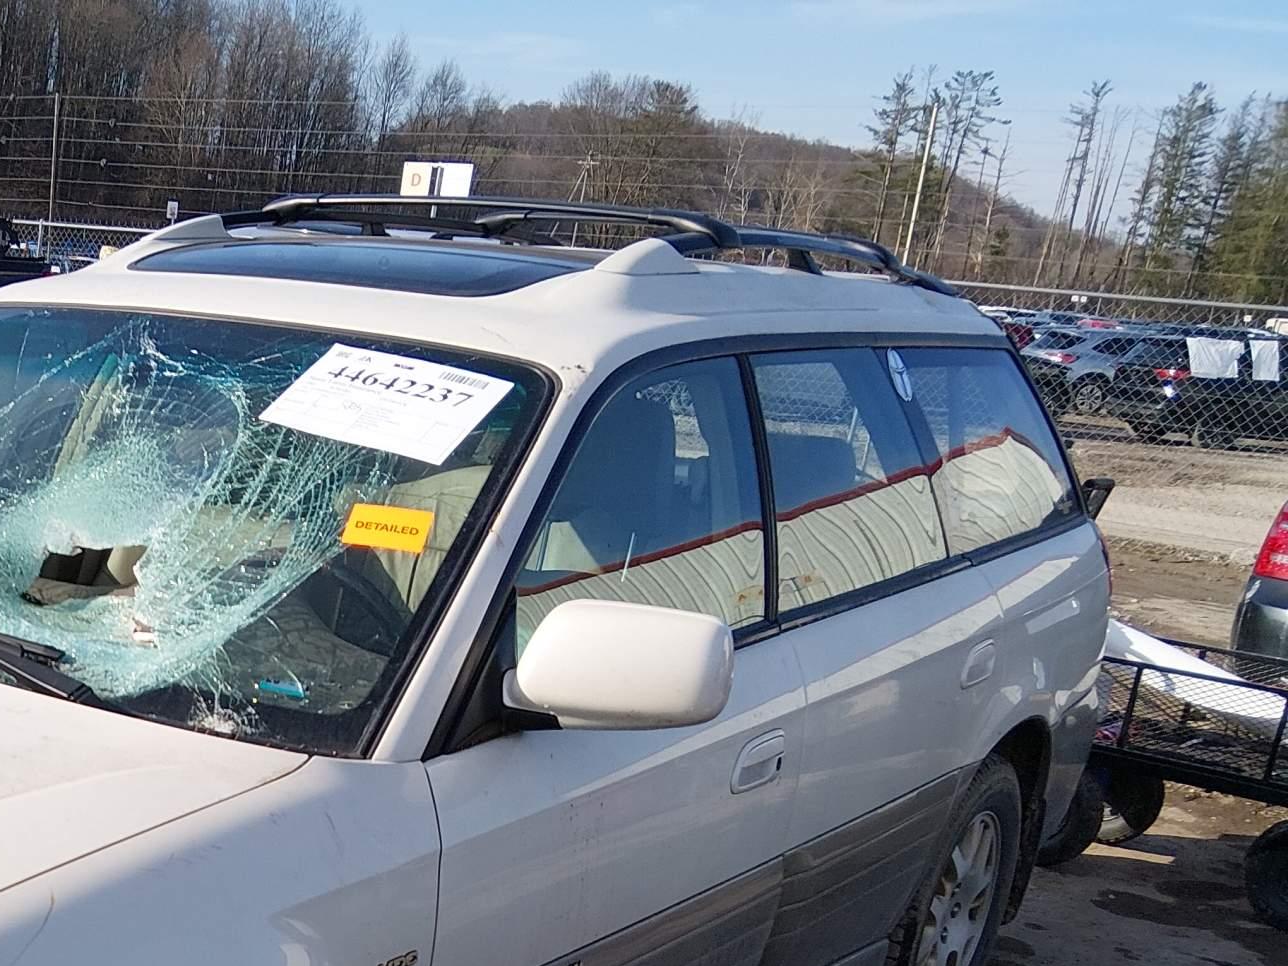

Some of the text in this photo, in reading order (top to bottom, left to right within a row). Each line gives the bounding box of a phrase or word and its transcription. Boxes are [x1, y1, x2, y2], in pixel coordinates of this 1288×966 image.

[411, 173, 422, 187] D
[328, 365, 475, 408] 44642237
[355, 520, 420, 536] DETAILED
